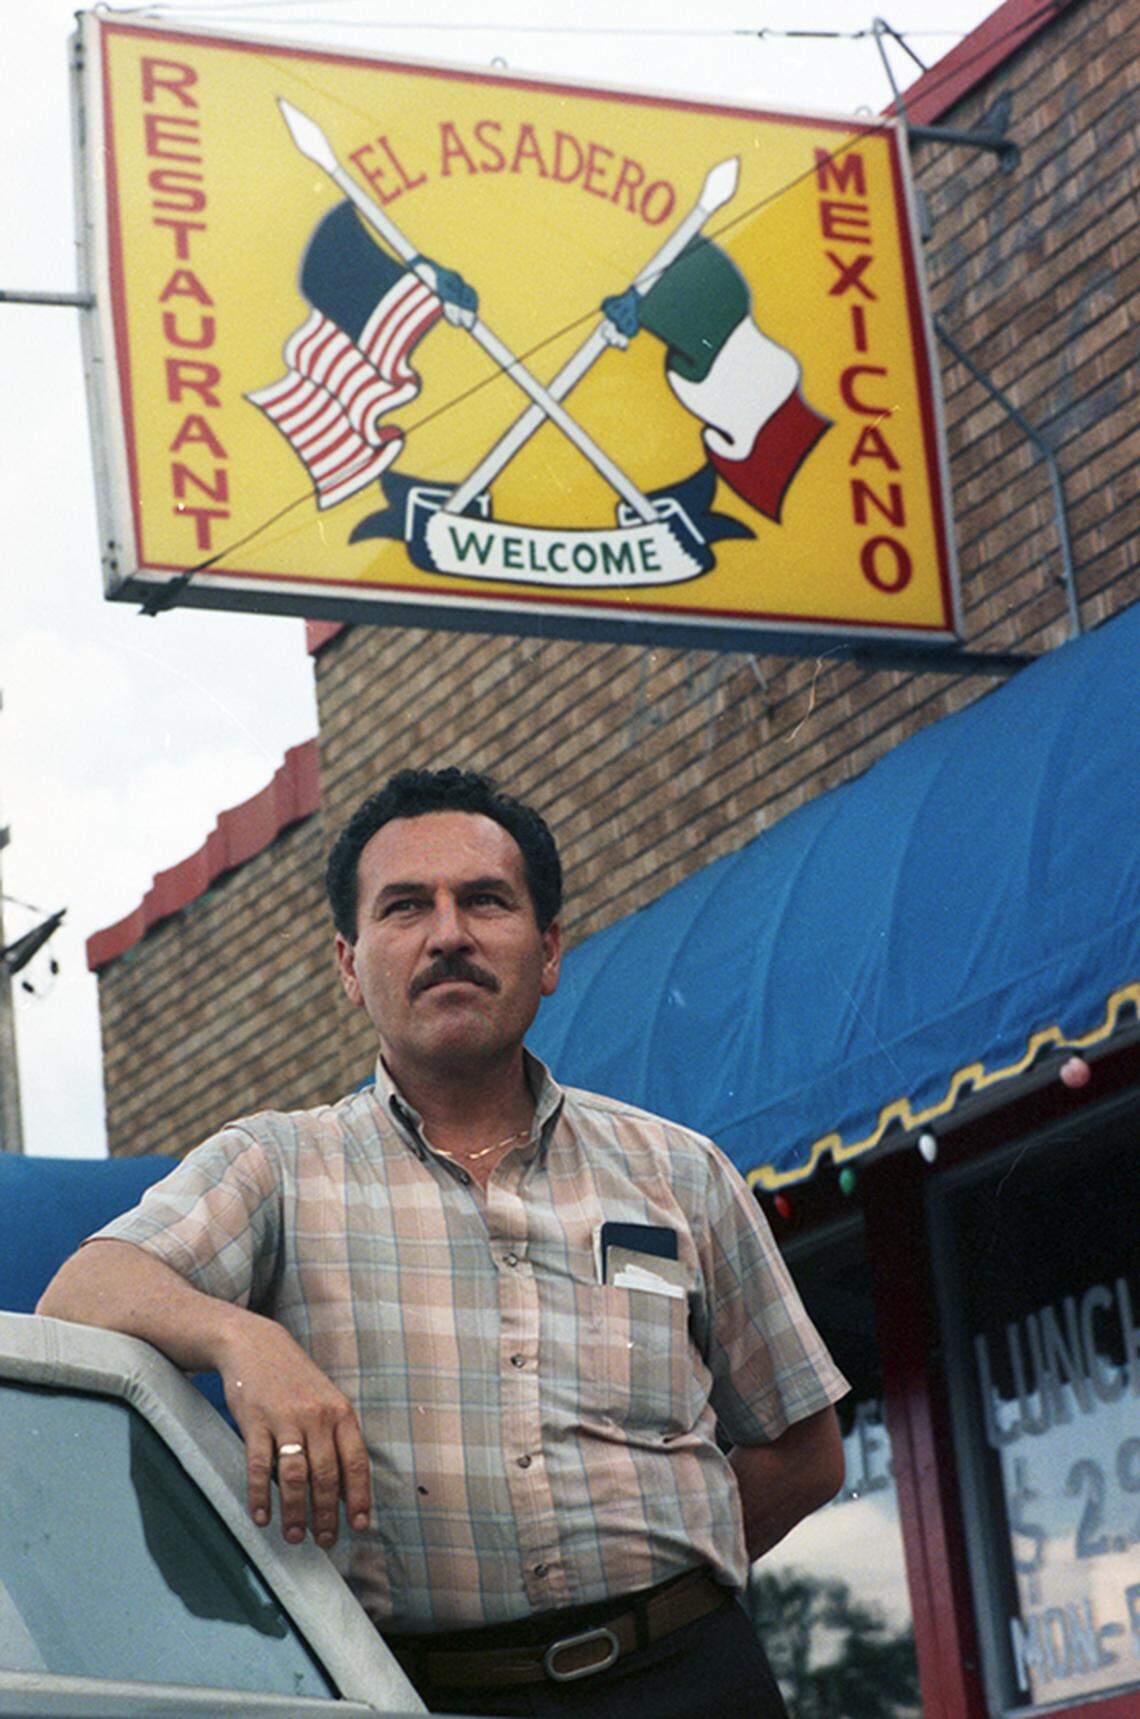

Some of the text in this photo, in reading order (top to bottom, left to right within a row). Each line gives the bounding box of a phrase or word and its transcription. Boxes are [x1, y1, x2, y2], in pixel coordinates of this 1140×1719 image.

[140, 57, 230, 551] RESTAURANT
[348, 120, 675, 227] EL ASADERO
[814, 148, 913, 595] MEXICANO
[449, 525, 663, 575] WELCOME
